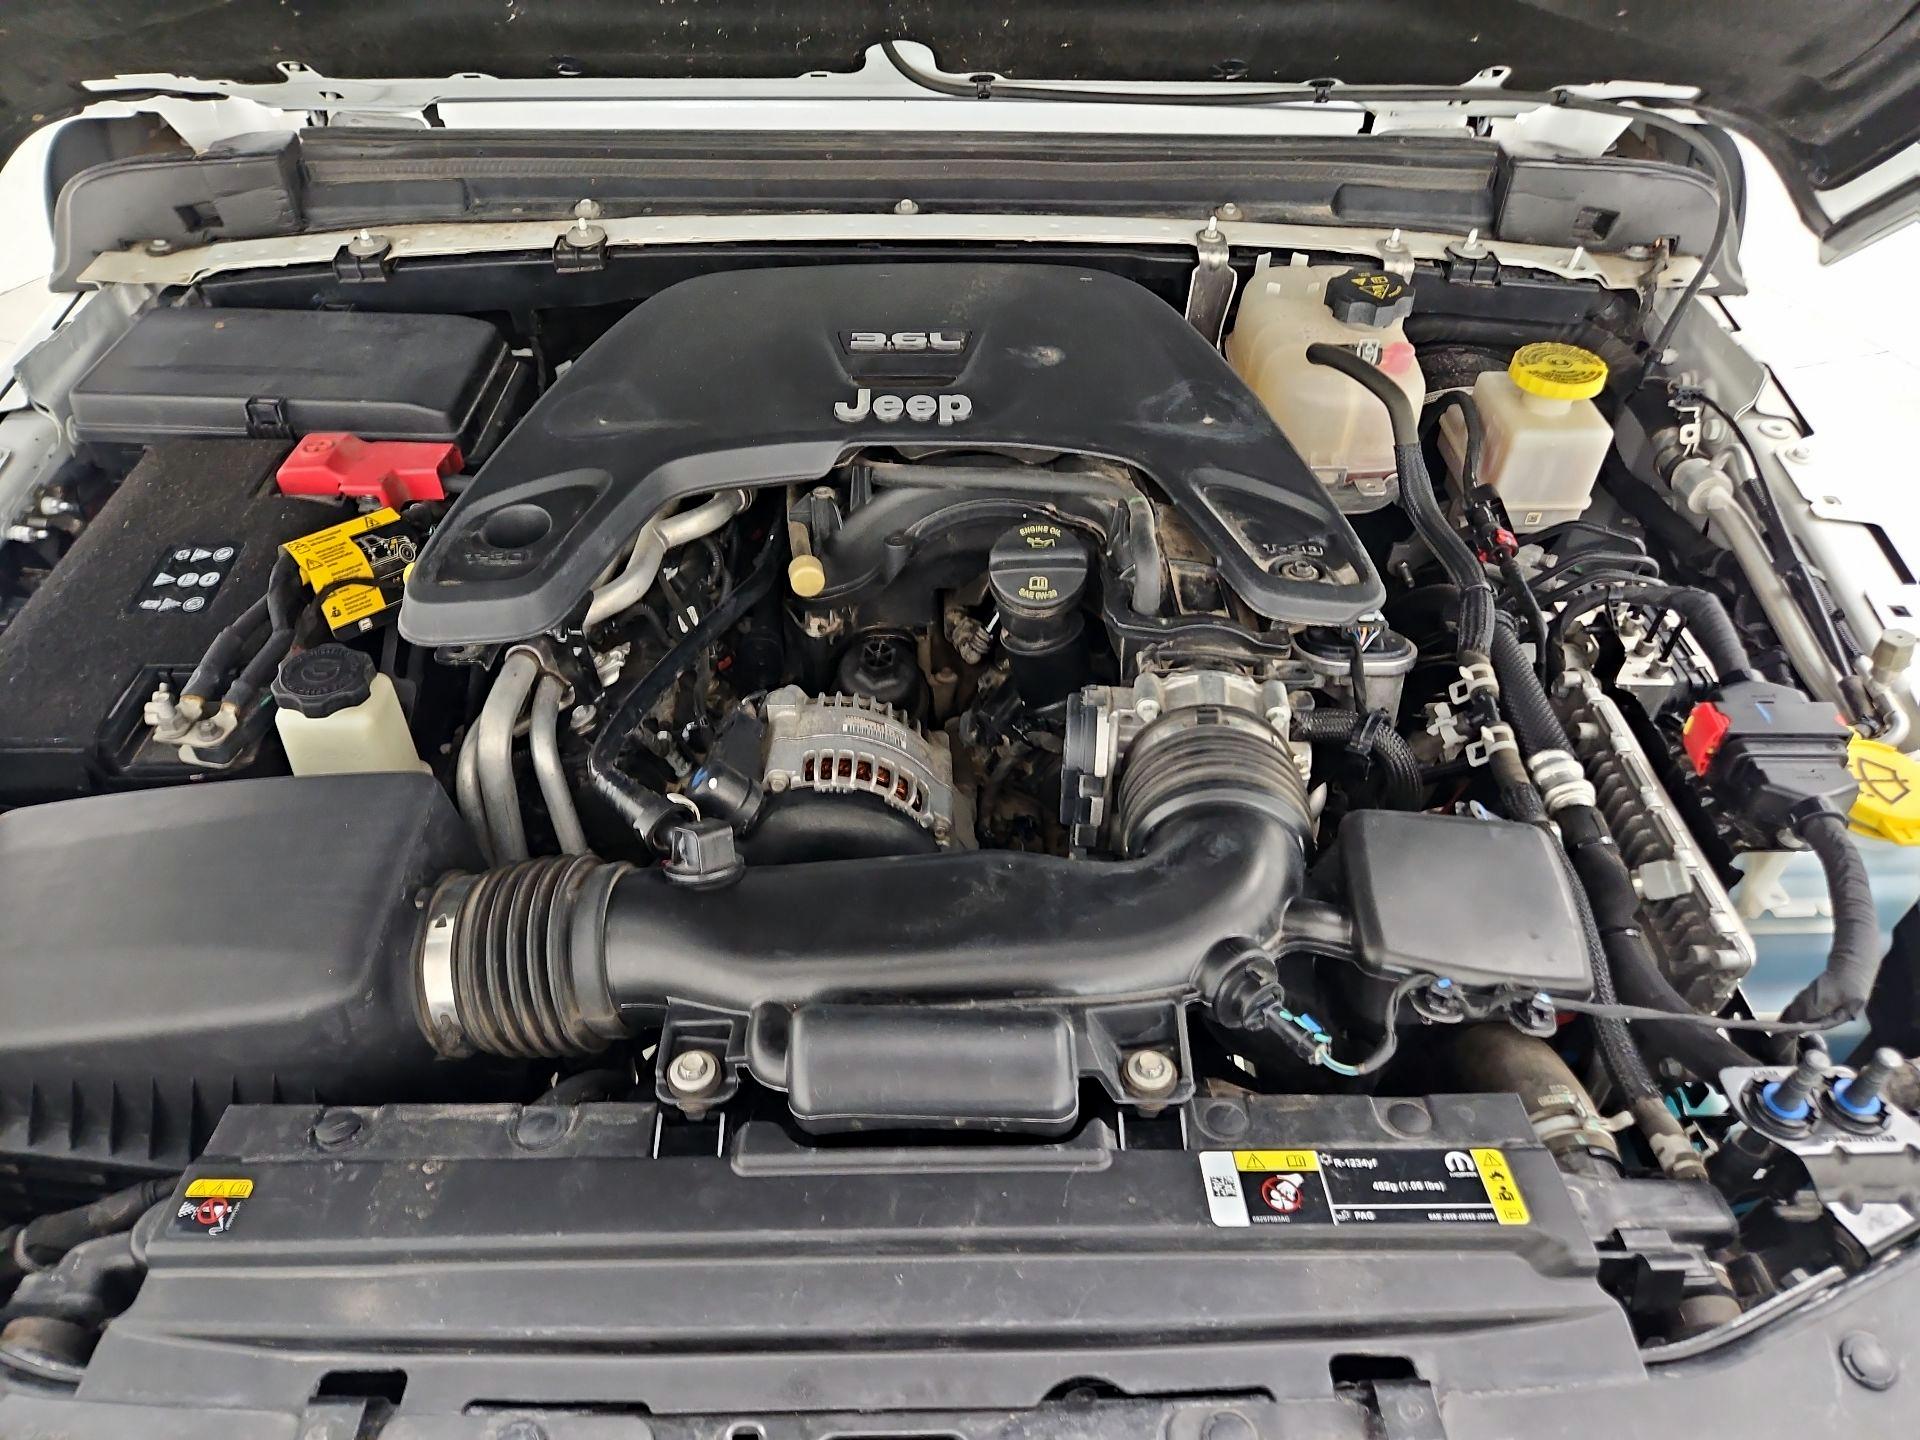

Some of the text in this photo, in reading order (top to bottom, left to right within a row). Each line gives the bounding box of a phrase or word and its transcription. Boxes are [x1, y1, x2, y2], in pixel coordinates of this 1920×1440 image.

[850, 332, 962, 350] 3.6L
[834, 388, 973, 426] Jeep
[1019, 525, 1061, 538] ENGINE OIL
[1333, 1158, 1378, 1169] R-1234yf
